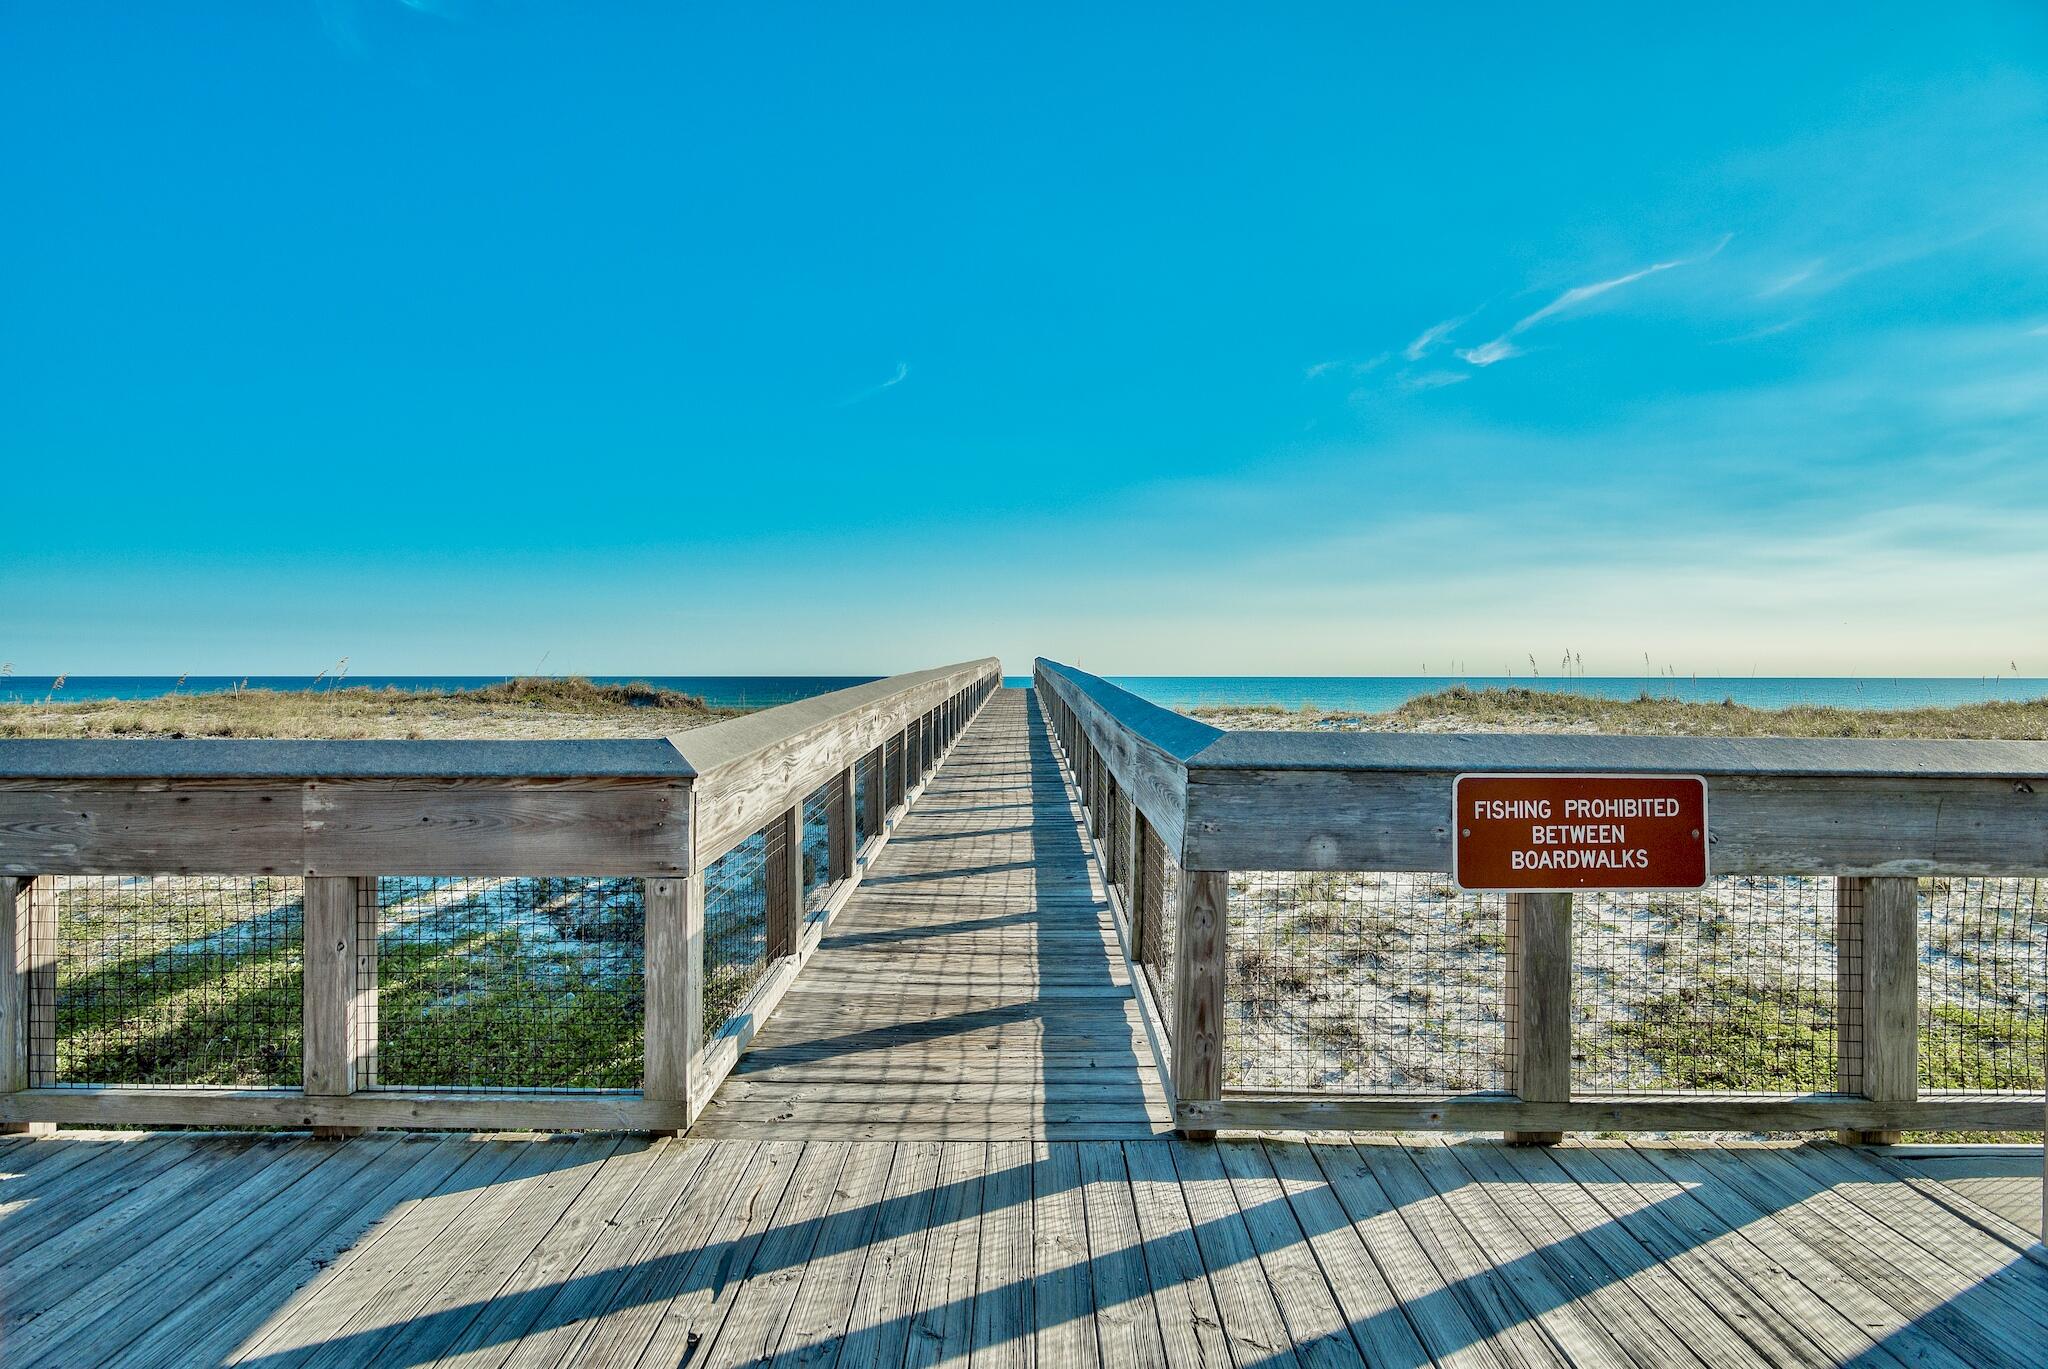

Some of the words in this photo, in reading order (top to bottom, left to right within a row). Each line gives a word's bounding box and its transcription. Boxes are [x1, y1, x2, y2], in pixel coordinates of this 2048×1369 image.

[1474, 800, 1551, 819] FISHING
[1564, 798, 1680, 819] PROHIBITED
[1532, 825, 1625, 844] BETWEEN
[1511, 849, 1649, 870] BOARDWALKS
